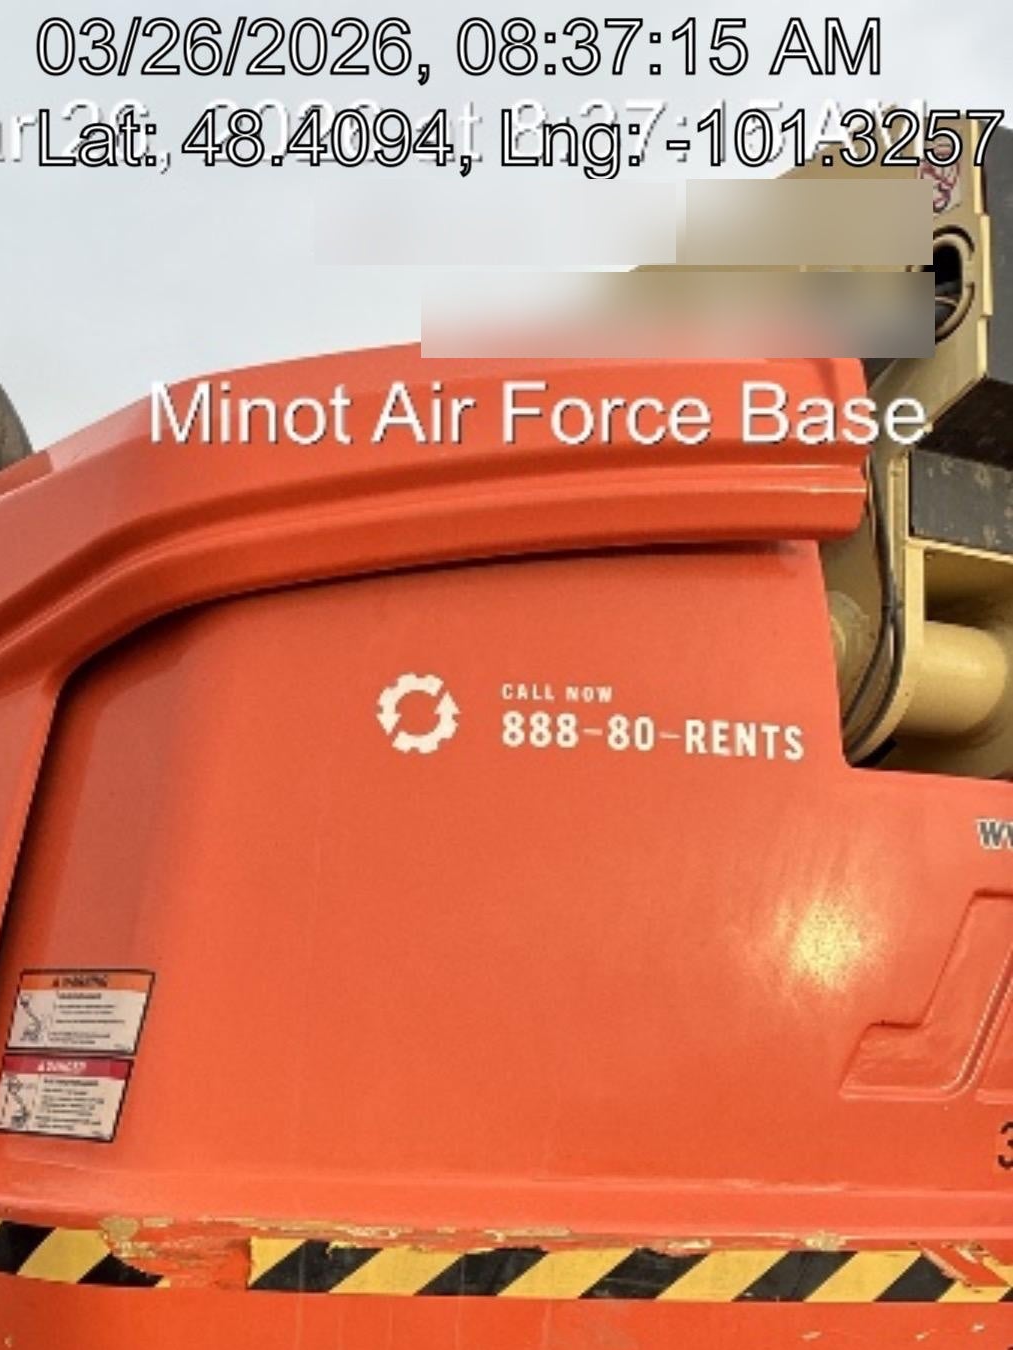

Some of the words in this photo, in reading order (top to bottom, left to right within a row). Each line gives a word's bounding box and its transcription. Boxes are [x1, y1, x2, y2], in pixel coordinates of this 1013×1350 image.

[501, 683, 555, 701] CALL
[565, 686, 613, 703] NOW
[501, 710, 805, 761] 888-80-RENTS
